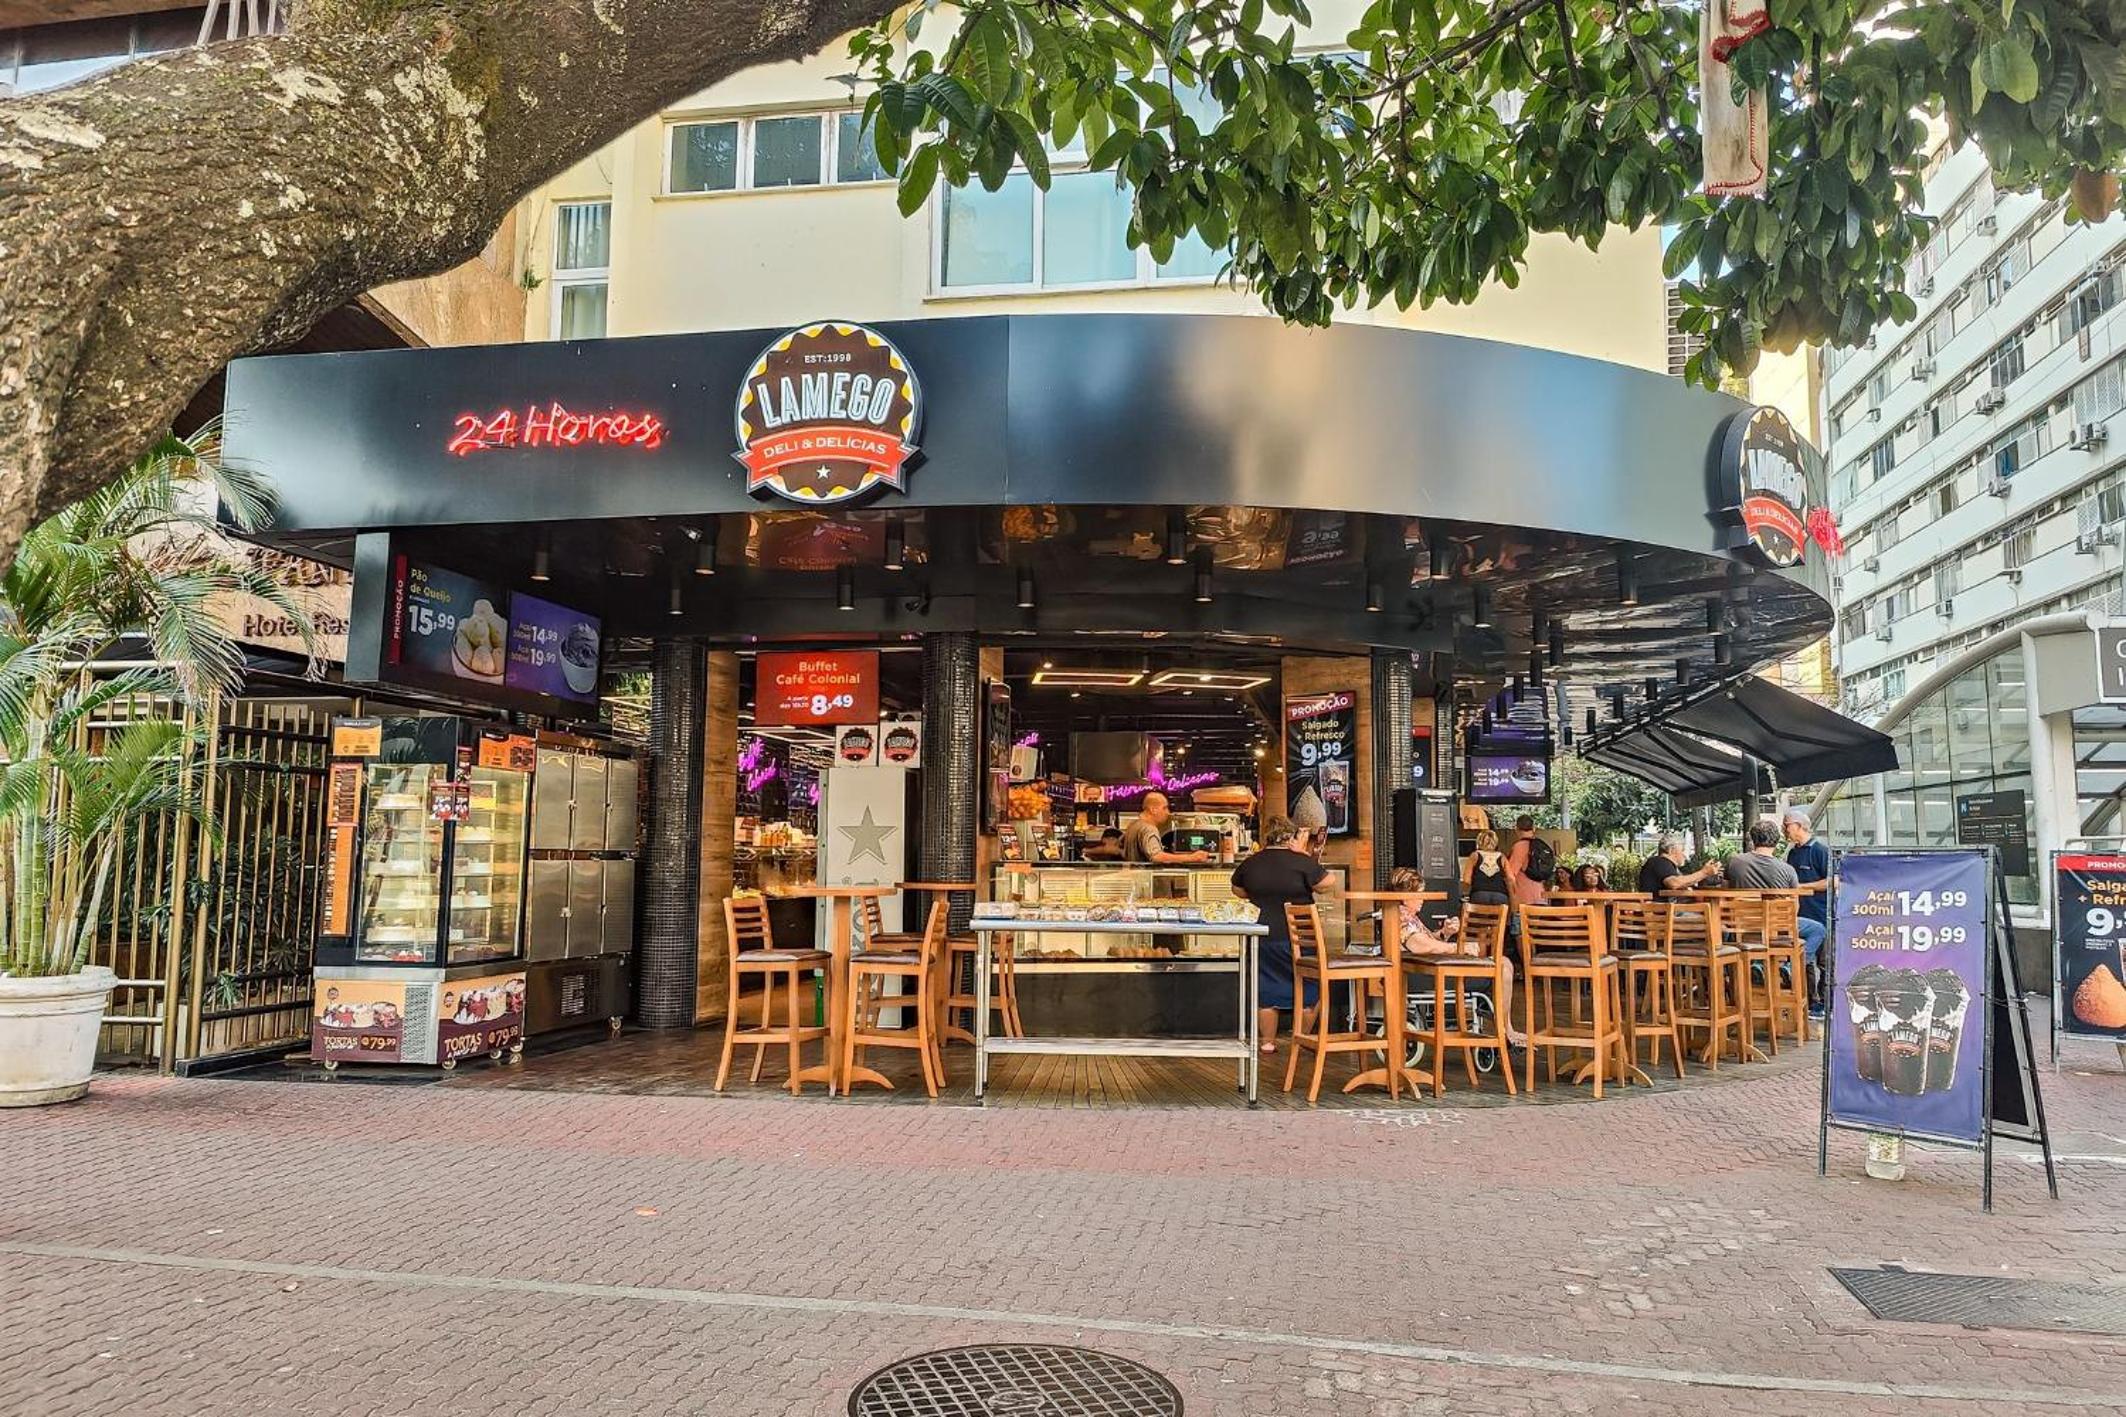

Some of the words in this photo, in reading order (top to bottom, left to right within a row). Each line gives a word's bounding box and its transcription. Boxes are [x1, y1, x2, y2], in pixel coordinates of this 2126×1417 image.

[757, 372, 897, 429] LAMEGO
[449, 409, 516, 453] 24
[523, 402, 662, 446] Horas
[763, 441, 799, 459] DELI
[801, 439, 814, 449] &
[815, 437, 888, 455] DELÍCIAS
[410, 567, 428, 582] Pão
[410, 583, 422, 594] de
[423, 586, 452, 604] Queijo
[394, 579, 404, 639] PROMOÇÃO
[243, 613, 300, 638] Hote
[408, 604, 456, 637] 15,99
[798, 661, 839, 672] Buffet
[775, 672, 805, 686] Café
[808, 673, 861, 685] Colonial
[810, 693, 854, 716] 8,49
[1290, 695, 1349, 718] PROMOÇÃO
[1301, 719, 1339, 731] Salgado
[1304, 730, 1346, 741] Refresco
[1300, 741, 1343, 767] 9,99
[1867, 889, 1896, 903] Açaí
[1897, 889, 1967, 917] 14,99
[1852, 903, 1895, 917] 300ml
[1865, 922, 1895, 937] Açaí
[1897, 925, 1967, 952] 19,99
[1851, 937, 1895, 950] 500ml
[323, 1036, 358, 1046] TORTAS
[444, 1032, 482, 1053] TORTAS
